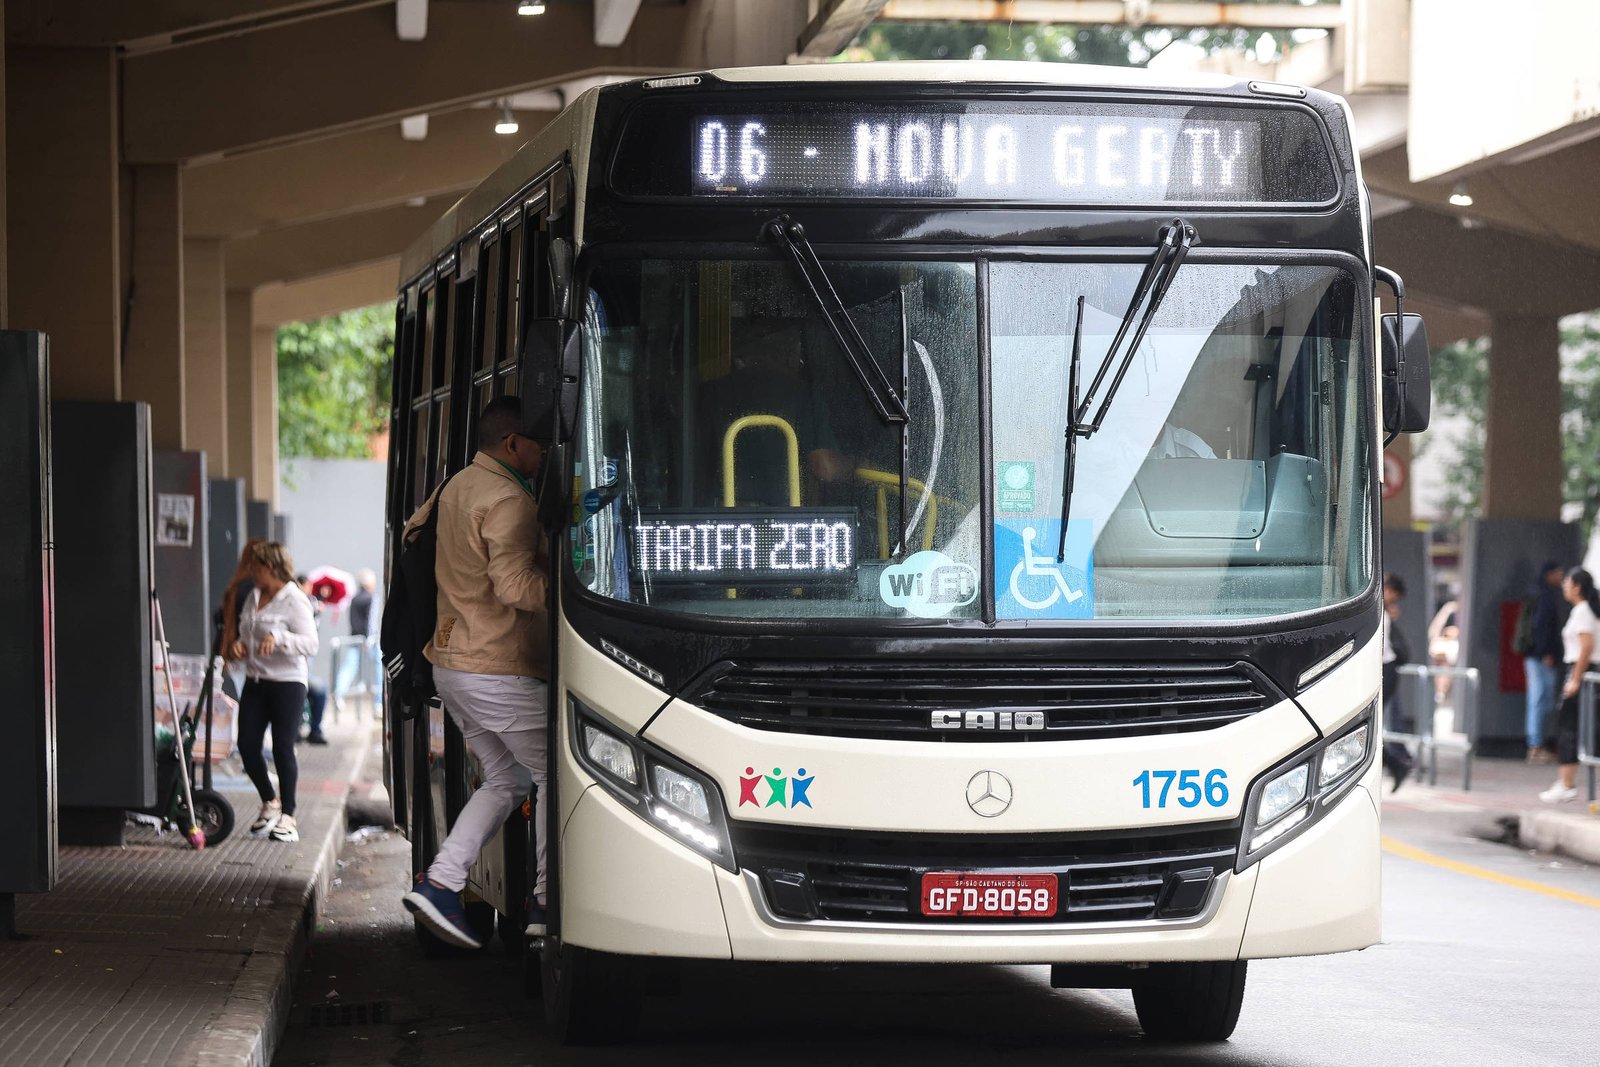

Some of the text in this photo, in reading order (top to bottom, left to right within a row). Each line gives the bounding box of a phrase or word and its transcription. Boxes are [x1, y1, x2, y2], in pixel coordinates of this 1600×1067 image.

[700, 119, 767, 184] 06
[853, 121, 1018, 187] NOVA
[1053, 123, 1242, 189] GERTY
[636, 521, 851, 571] TARIFA ZERO
[931, 710, 1045, 730] CAIO
[1132, 769, 1229, 809] 1756
